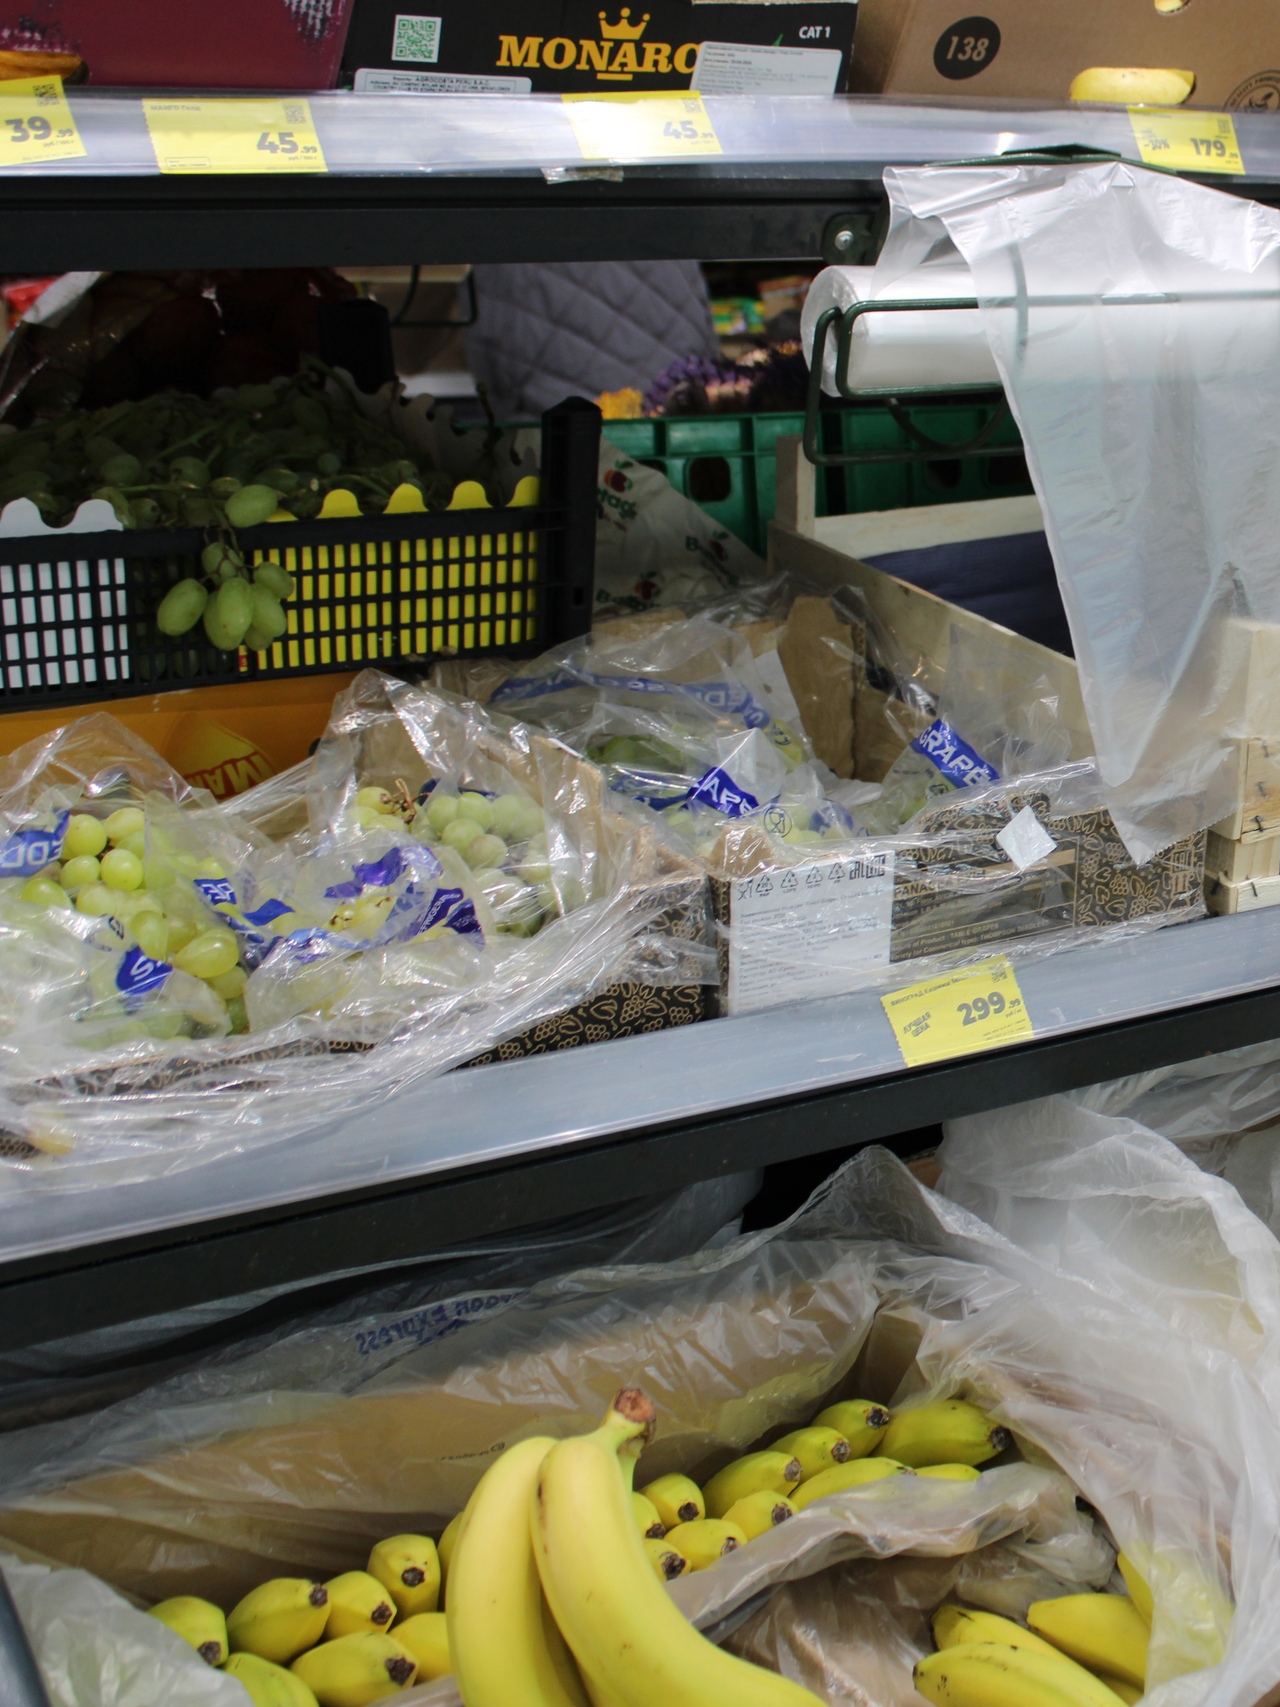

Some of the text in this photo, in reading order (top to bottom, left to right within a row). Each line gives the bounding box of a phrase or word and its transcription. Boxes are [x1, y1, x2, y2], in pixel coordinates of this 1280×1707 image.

[798, 26, 831, 39] CAT 1
[944, 35, 990, 62] 138
[5, 116, 53, 143] 39
[663, 120, 699, 139] 45
[257, 132, 300, 154] 45
[1190, 138, 1227, 158] 179
[890, 990, 925, 1006] ВИНОГРАД
[956, 991, 1006, 1026] 299
